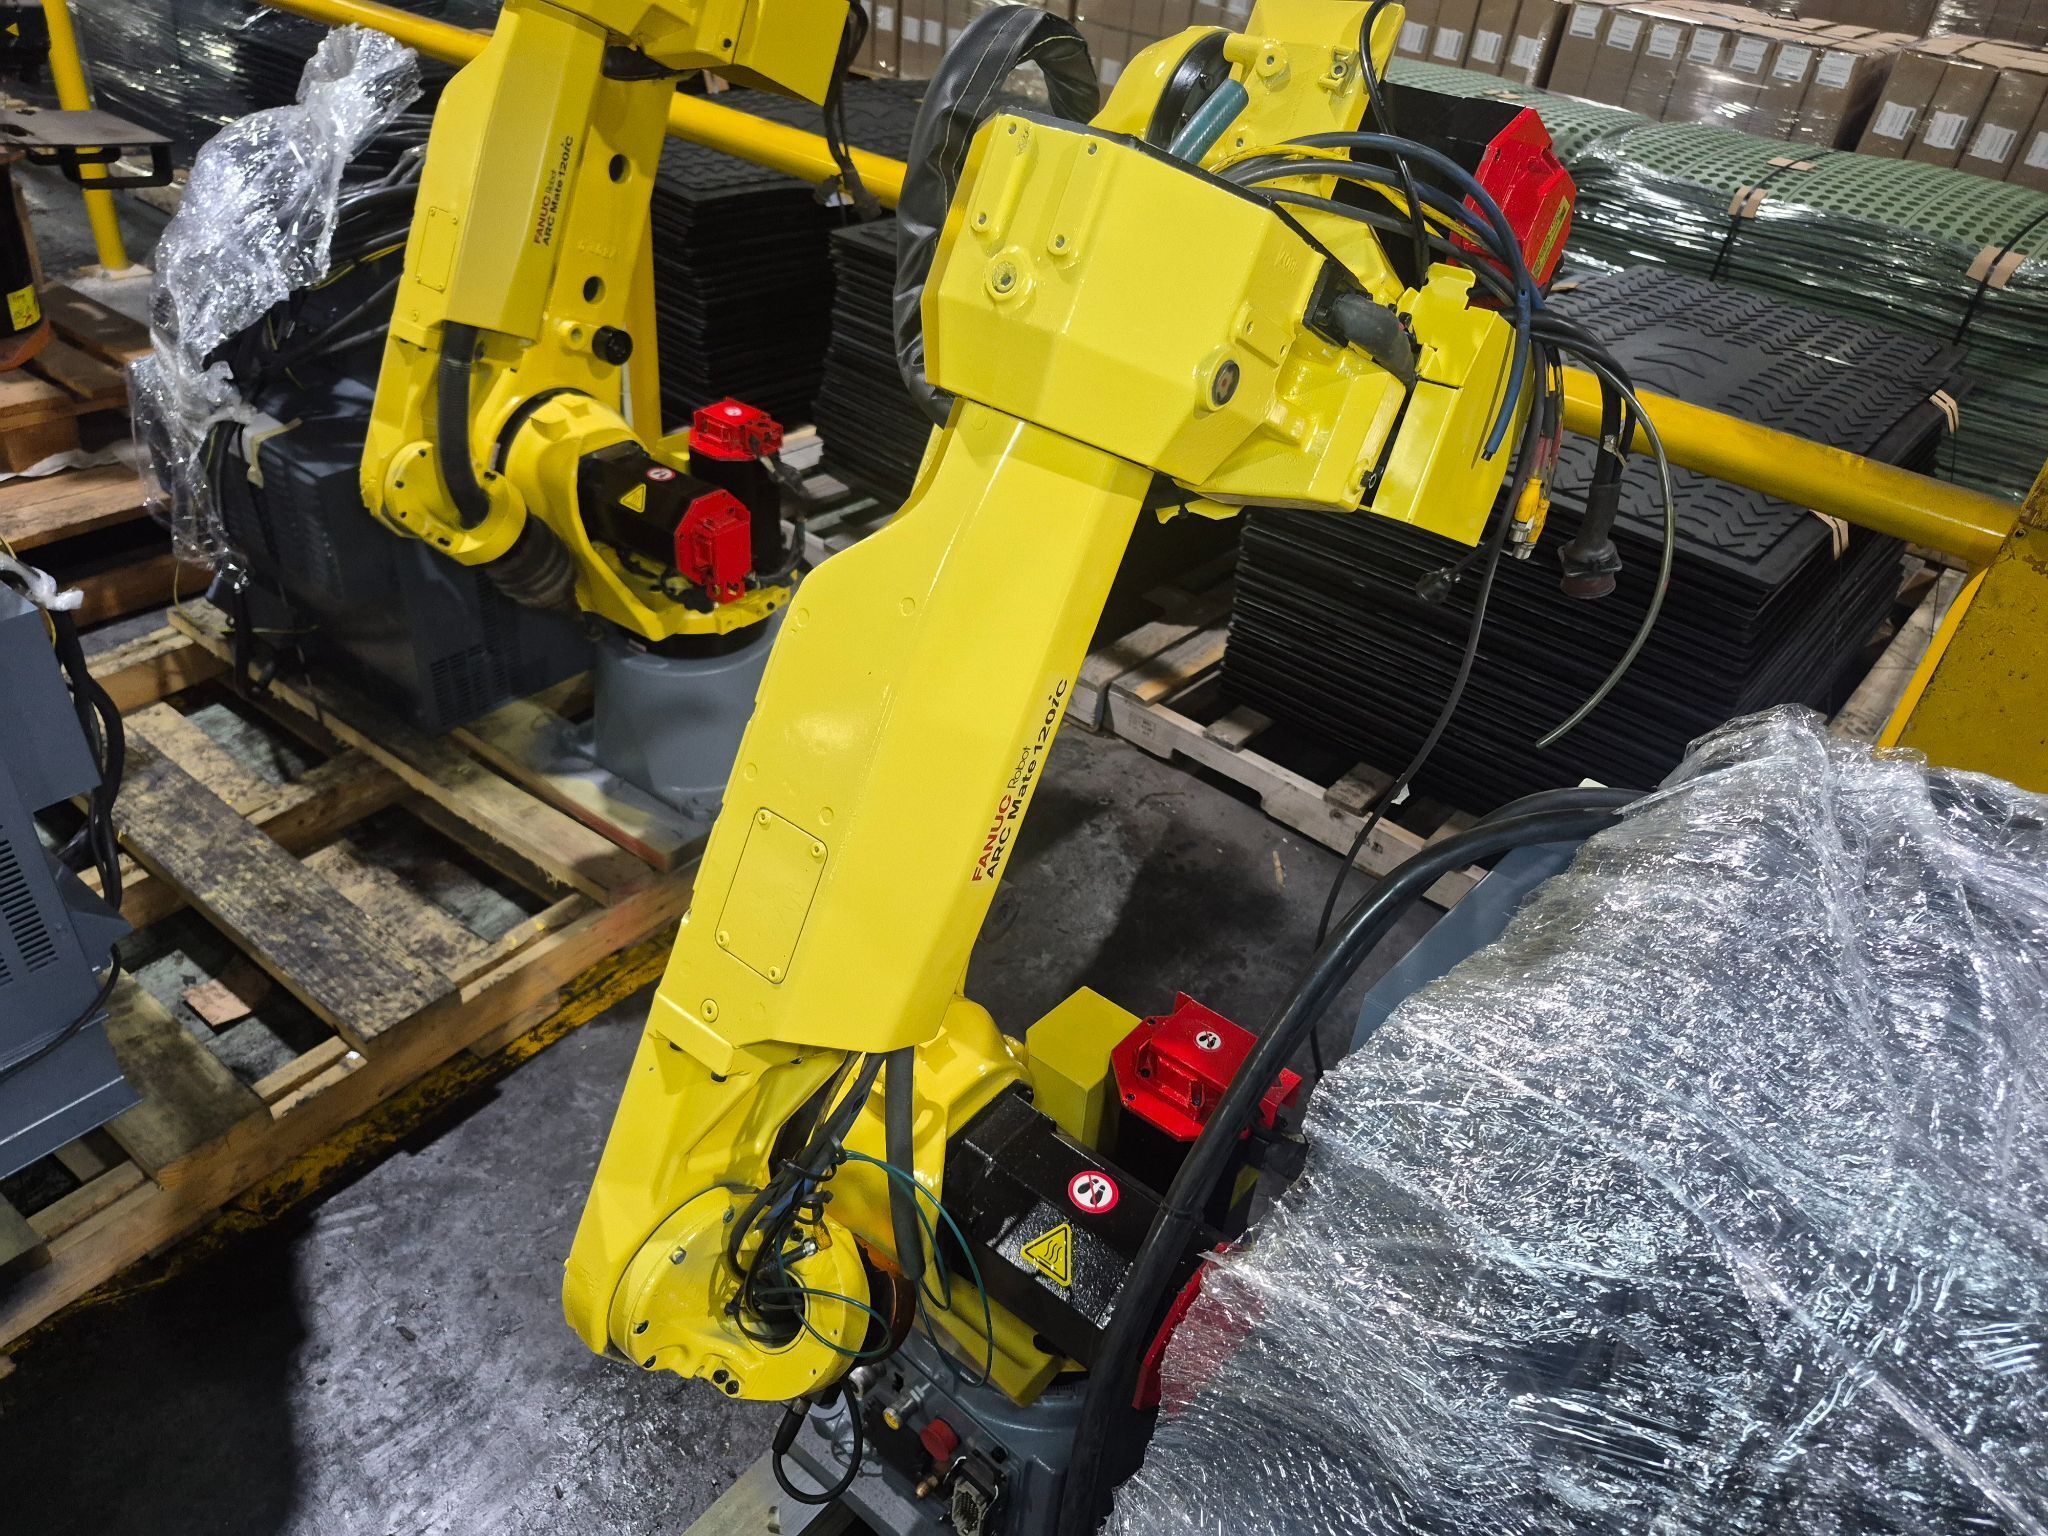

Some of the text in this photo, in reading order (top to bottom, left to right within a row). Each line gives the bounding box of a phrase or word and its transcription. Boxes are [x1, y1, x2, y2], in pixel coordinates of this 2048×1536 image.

[534, 196, 551, 244] FANUC
[542, 216, 555, 246] ARC
[550, 180, 563, 213] Mate
[972, 746, 1031, 881] FANUC Robot
[987, 679, 1067, 878] ARC Mate 120iC
